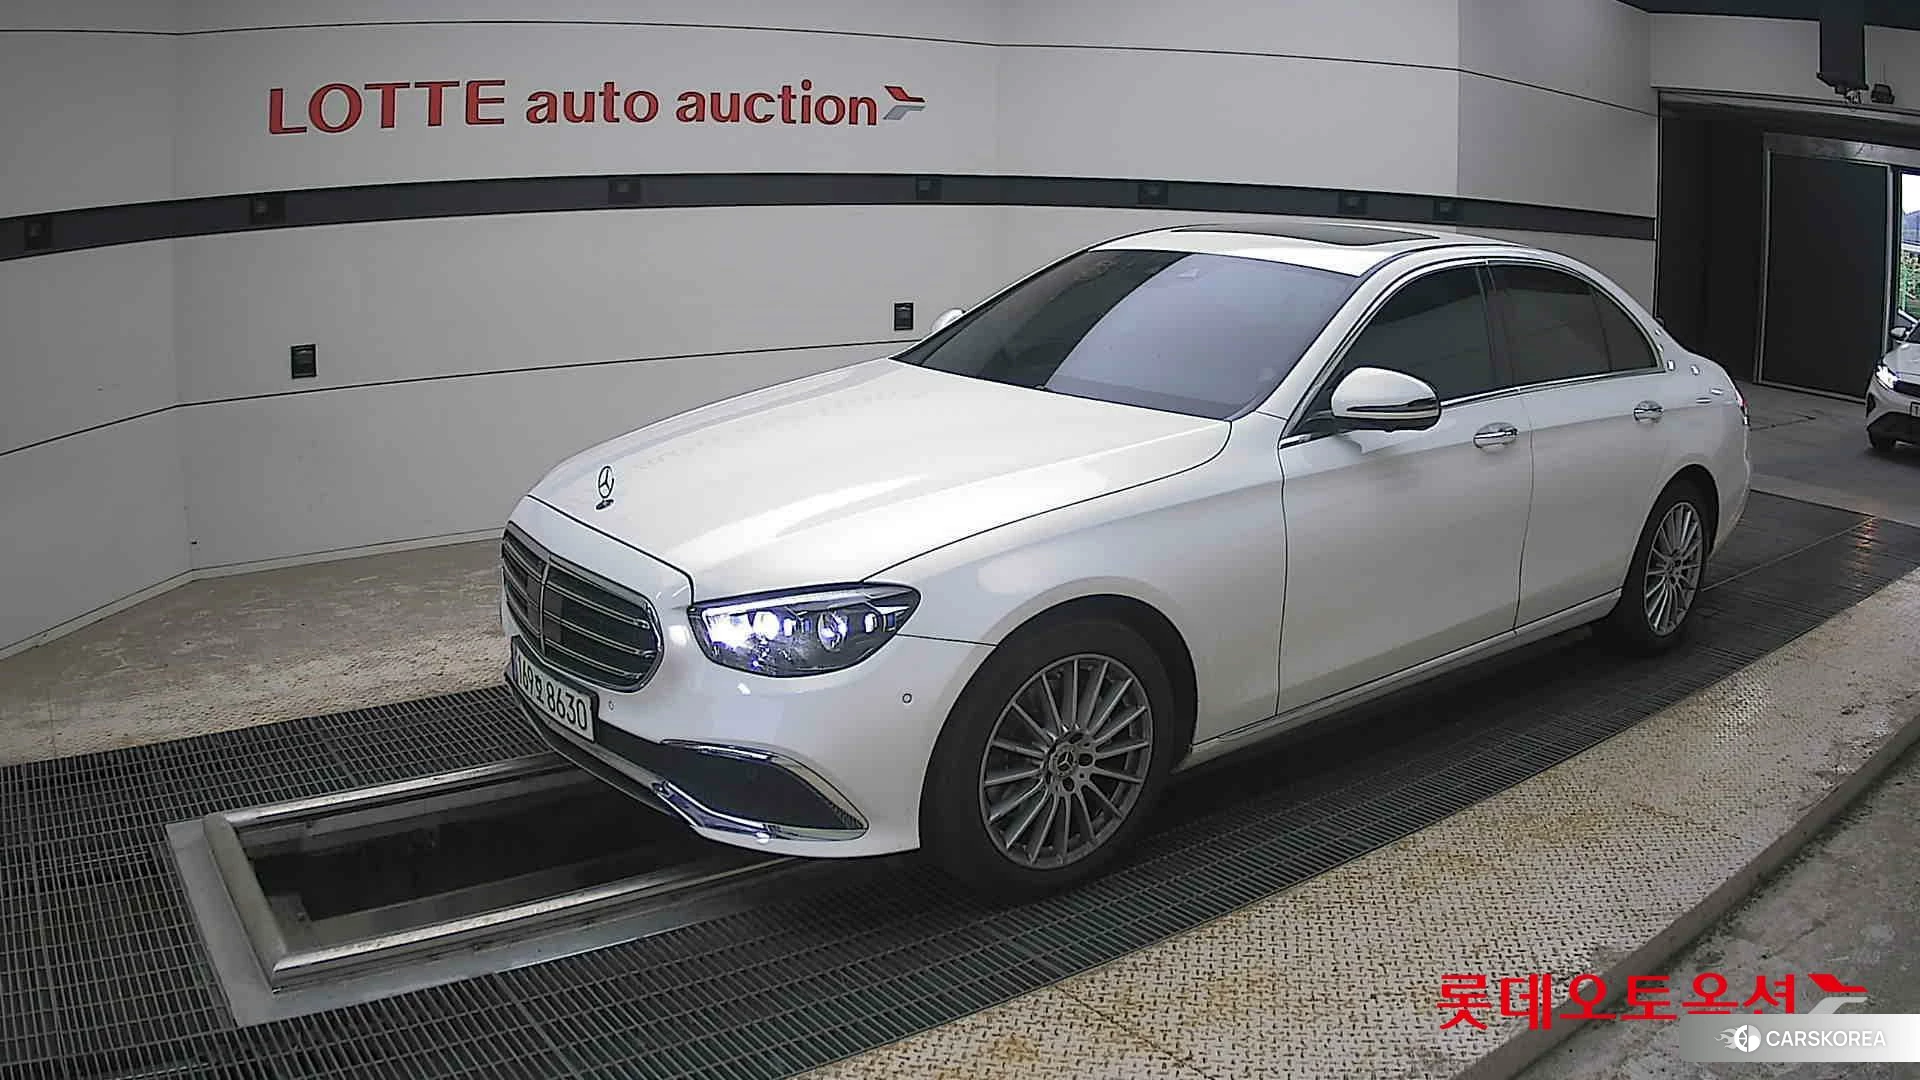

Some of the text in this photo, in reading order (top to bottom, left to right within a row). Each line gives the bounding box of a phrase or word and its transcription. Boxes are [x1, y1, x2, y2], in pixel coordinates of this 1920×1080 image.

[268, 79, 878, 134] LOTTE auto auction
[546, 681, 587, 730] 8630
